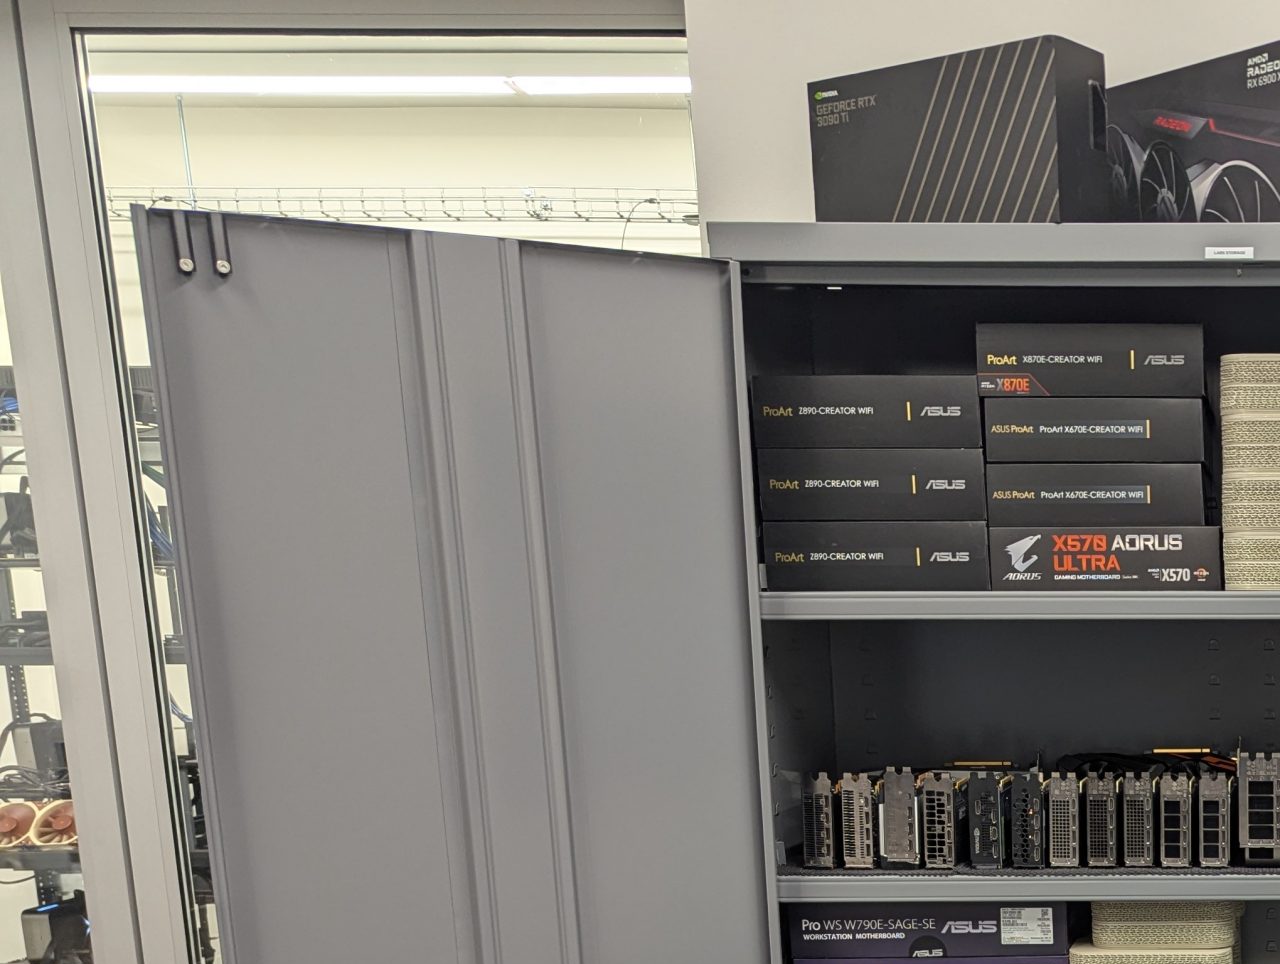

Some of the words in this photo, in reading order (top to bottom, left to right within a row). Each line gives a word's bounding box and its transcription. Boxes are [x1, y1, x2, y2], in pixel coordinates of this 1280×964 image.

[1247, 79, 1258, 89] RX
[1258, 73, 1277, 86] 6900
[816, 98, 857, 115] GEFORCE
[858, 95, 877, 109] RTX
[816, 112, 840, 127] 3090
[987, 354, 1017, 365] ProArt
[1022, 355, 1086, 364] X870E-CREATOR
[1087, 355, 1103, 364] WIFI
[1144, 355, 1185, 366] ASUS
[996, 378, 1030, 392] X870E
[763, 406, 794, 417] ProArt
[798, 406, 857, 415] Z890-CREATOR
[858, 406, 874, 415] WIFI
[920, 406, 961, 417] ASUS
[991, 425, 1010, 434] ASUS
[1010, 425, 1034, 435] ProArt
[1039, 425, 1063, 434] ProArt
[1064, 425, 1126, 434] X670E-CREATOR
[1127, 425, 1143, 434] WIFI
[769, 479, 800, 490] ProArt
[804, 480, 862, 488] Z890-CREATOR
[863, 480, 880, 488] WIFI
[925, 479, 966, 490] ASUS
[992, 490, 1011, 499] ASUS
[1012, 490, 1035, 500] ProArt
[1041, 490, 1065, 499] ProArt
[1065, 490, 1127, 499] X670E-CREATOR
[1128, 490, 1144, 499] WIFI
[1052, 534, 1107, 551] X570
[1111, 534, 1183, 551] AORUS
[775, 552, 805, 563] ProArt
[810, 552, 867, 561] Z890-CREATOR
[868, 552, 884, 561] WIFI
[929, 551, 970, 563] ASUS
[1053, 554, 1121, 571] ULTRA
[1002, 572, 1042, 581] AORUS
[1162, 568, 1191, 582] X570
[801, 919, 821, 931] Pro
[822, 919, 844, 931] WS
[845, 918, 936, 930] W790E-SAGE-SE
[941, 920, 997, 934] ASUS
[803, 932, 852, 940] WORKSTATION
[912, 948, 943, 957] ASUS
